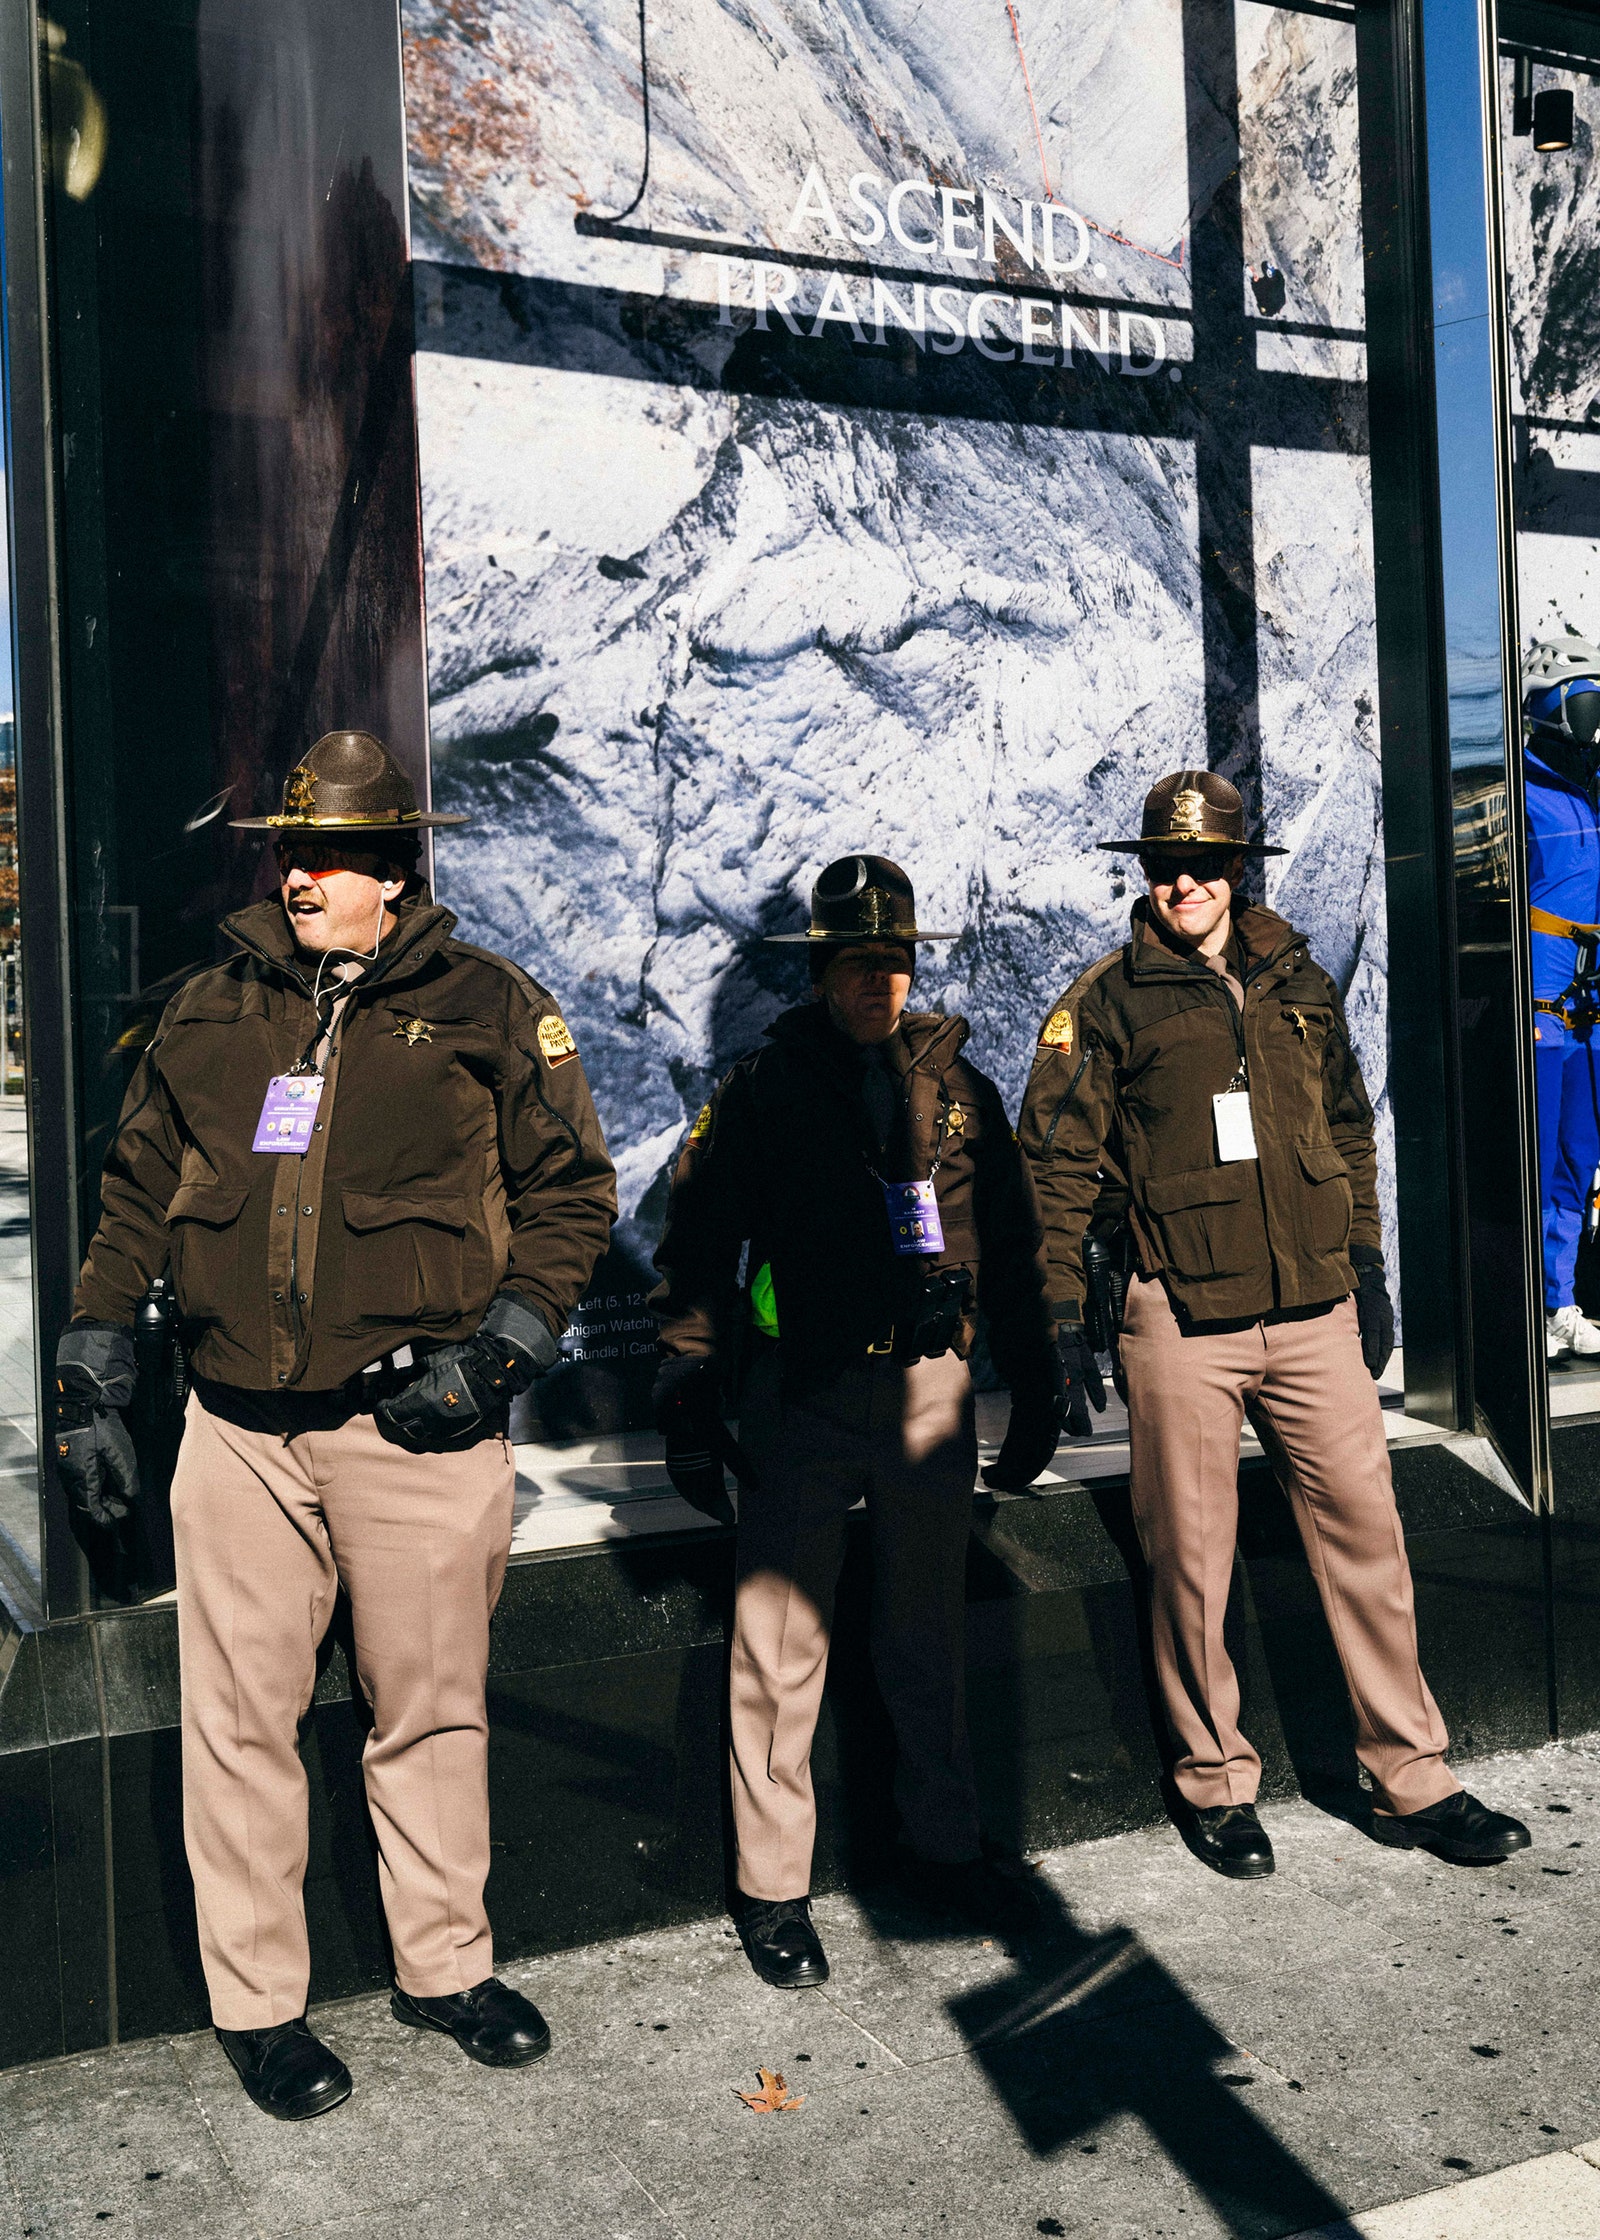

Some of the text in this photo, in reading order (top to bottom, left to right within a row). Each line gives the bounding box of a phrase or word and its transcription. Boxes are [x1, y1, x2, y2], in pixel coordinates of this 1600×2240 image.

[785, 161, 1108, 279] ASCEND.
[700, 252, 1183, 383] TRANSCEND.
[561, 1323, 606, 1338] ahigan
[574, 1345, 619, 1361] Rundle
